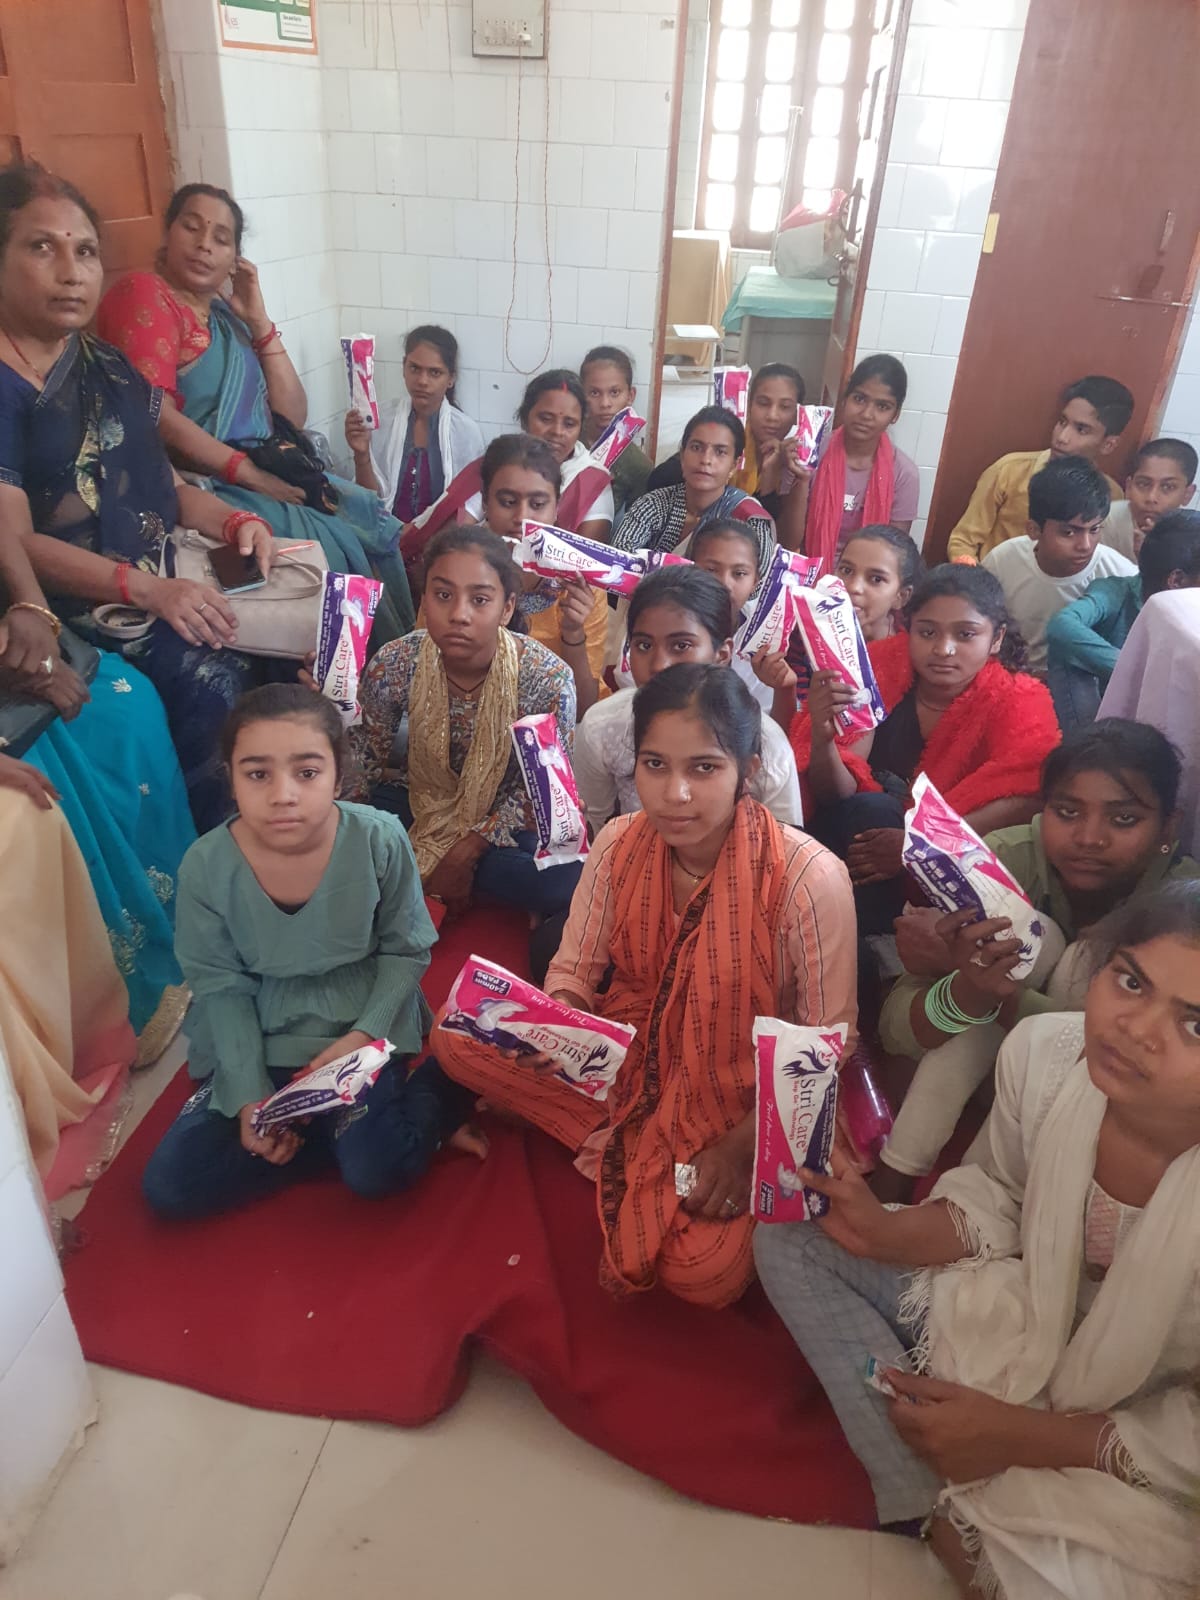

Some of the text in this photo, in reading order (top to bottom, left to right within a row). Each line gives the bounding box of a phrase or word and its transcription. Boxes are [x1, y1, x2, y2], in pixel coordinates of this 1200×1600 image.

[545, 543, 594, 568] Stri Care
[764, 604, 782, 630] Care
[830, 609, 858, 667] Stri Care
[331, 639, 348, 697] Stri Care
[552, 788, 568, 840] Stri Care
[473, 977, 505, 993] 240mm
[476, 971, 508, 988] 7 PADS
[530, 994, 546, 1006] dry
[554, 1004, 570, 1017] free
[569, 1012, 588, 1026] Feel
[523, 1026, 586, 1065] Stri Care
[788, 1108, 798, 1140] Technology
[795, 1078, 816, 1148] Stri Care
